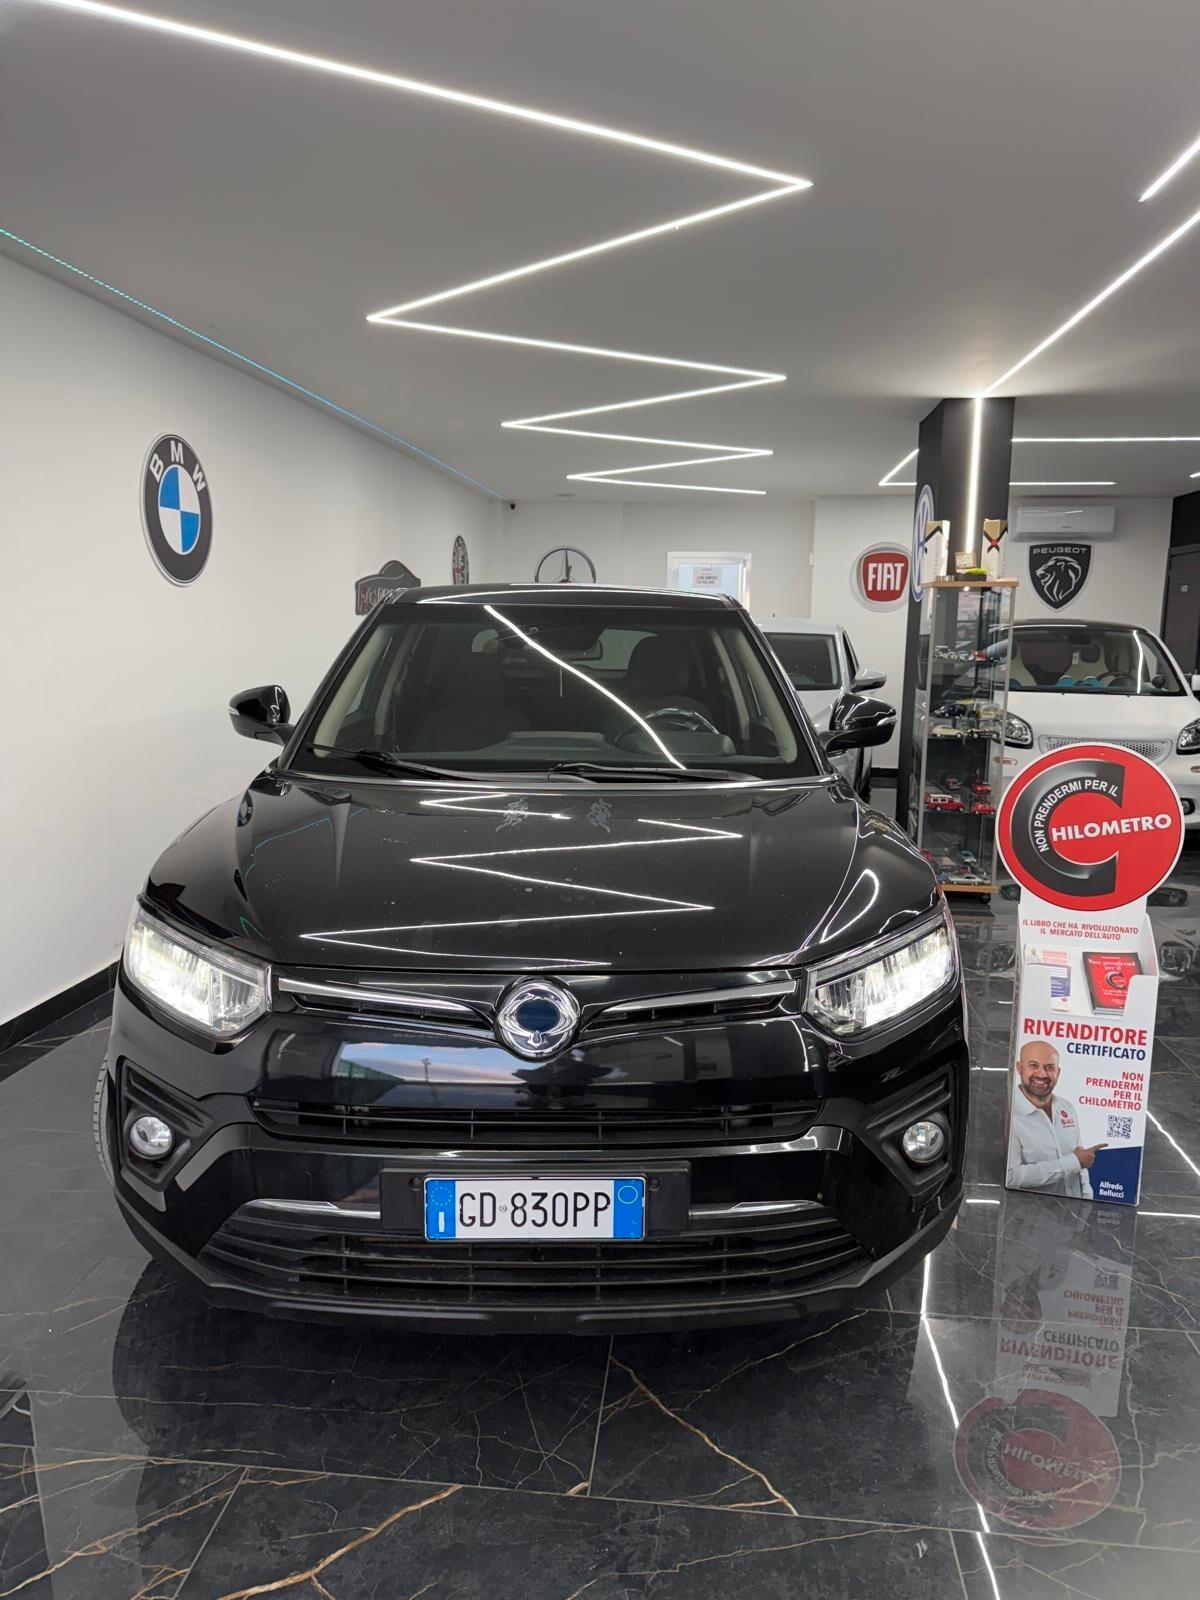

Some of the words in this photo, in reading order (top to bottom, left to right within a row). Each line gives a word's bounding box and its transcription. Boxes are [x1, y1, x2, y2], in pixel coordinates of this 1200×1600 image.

[149, 440, 206, 492] BMW
[1032, 545, 1088, 555] PEUGEOT
[867, 562, 905, 591] FIAT
[1085, 779, 1107, 791] PER
[1109, 785, 1119, 797] IL
[1034, 782, 1083, 827] PRENDERMI
[1034, 829, 1050, 853] NON
[1030, 920, 1051, 928] LIBRO
[1052, 921, 1067, 929] CHE
[1068, 922, 1079, 930] HA
[1081, 923, 1139, 934] RIVOLUZIONATO
[1049, 929, 1083, 938] MERCATO
[1084, 931, 1121, 941] DELL'AUTO
[1023, 1018, 1148, 1046] RIVENDITORE
[1066, 1042, 1146, 1061] CERTIFICATO
[1121, 1071, 1144, 1082] NON
[1085, 1077, 1144, 1091] PRENDERMI
[1113, 1090, 1131, 1101] PER
[1133, 1092, 1143, 1101] IL
[1078, 1096, 1142, 1111] CHILOMETRO
[1099, 1181, 1124, 1190] Alfredo
[1099, 1189, 1124, 1199] Bellucci
[459, 1192, 497, 1227] GD
[510, 1192, 611, 1227] 830PP
